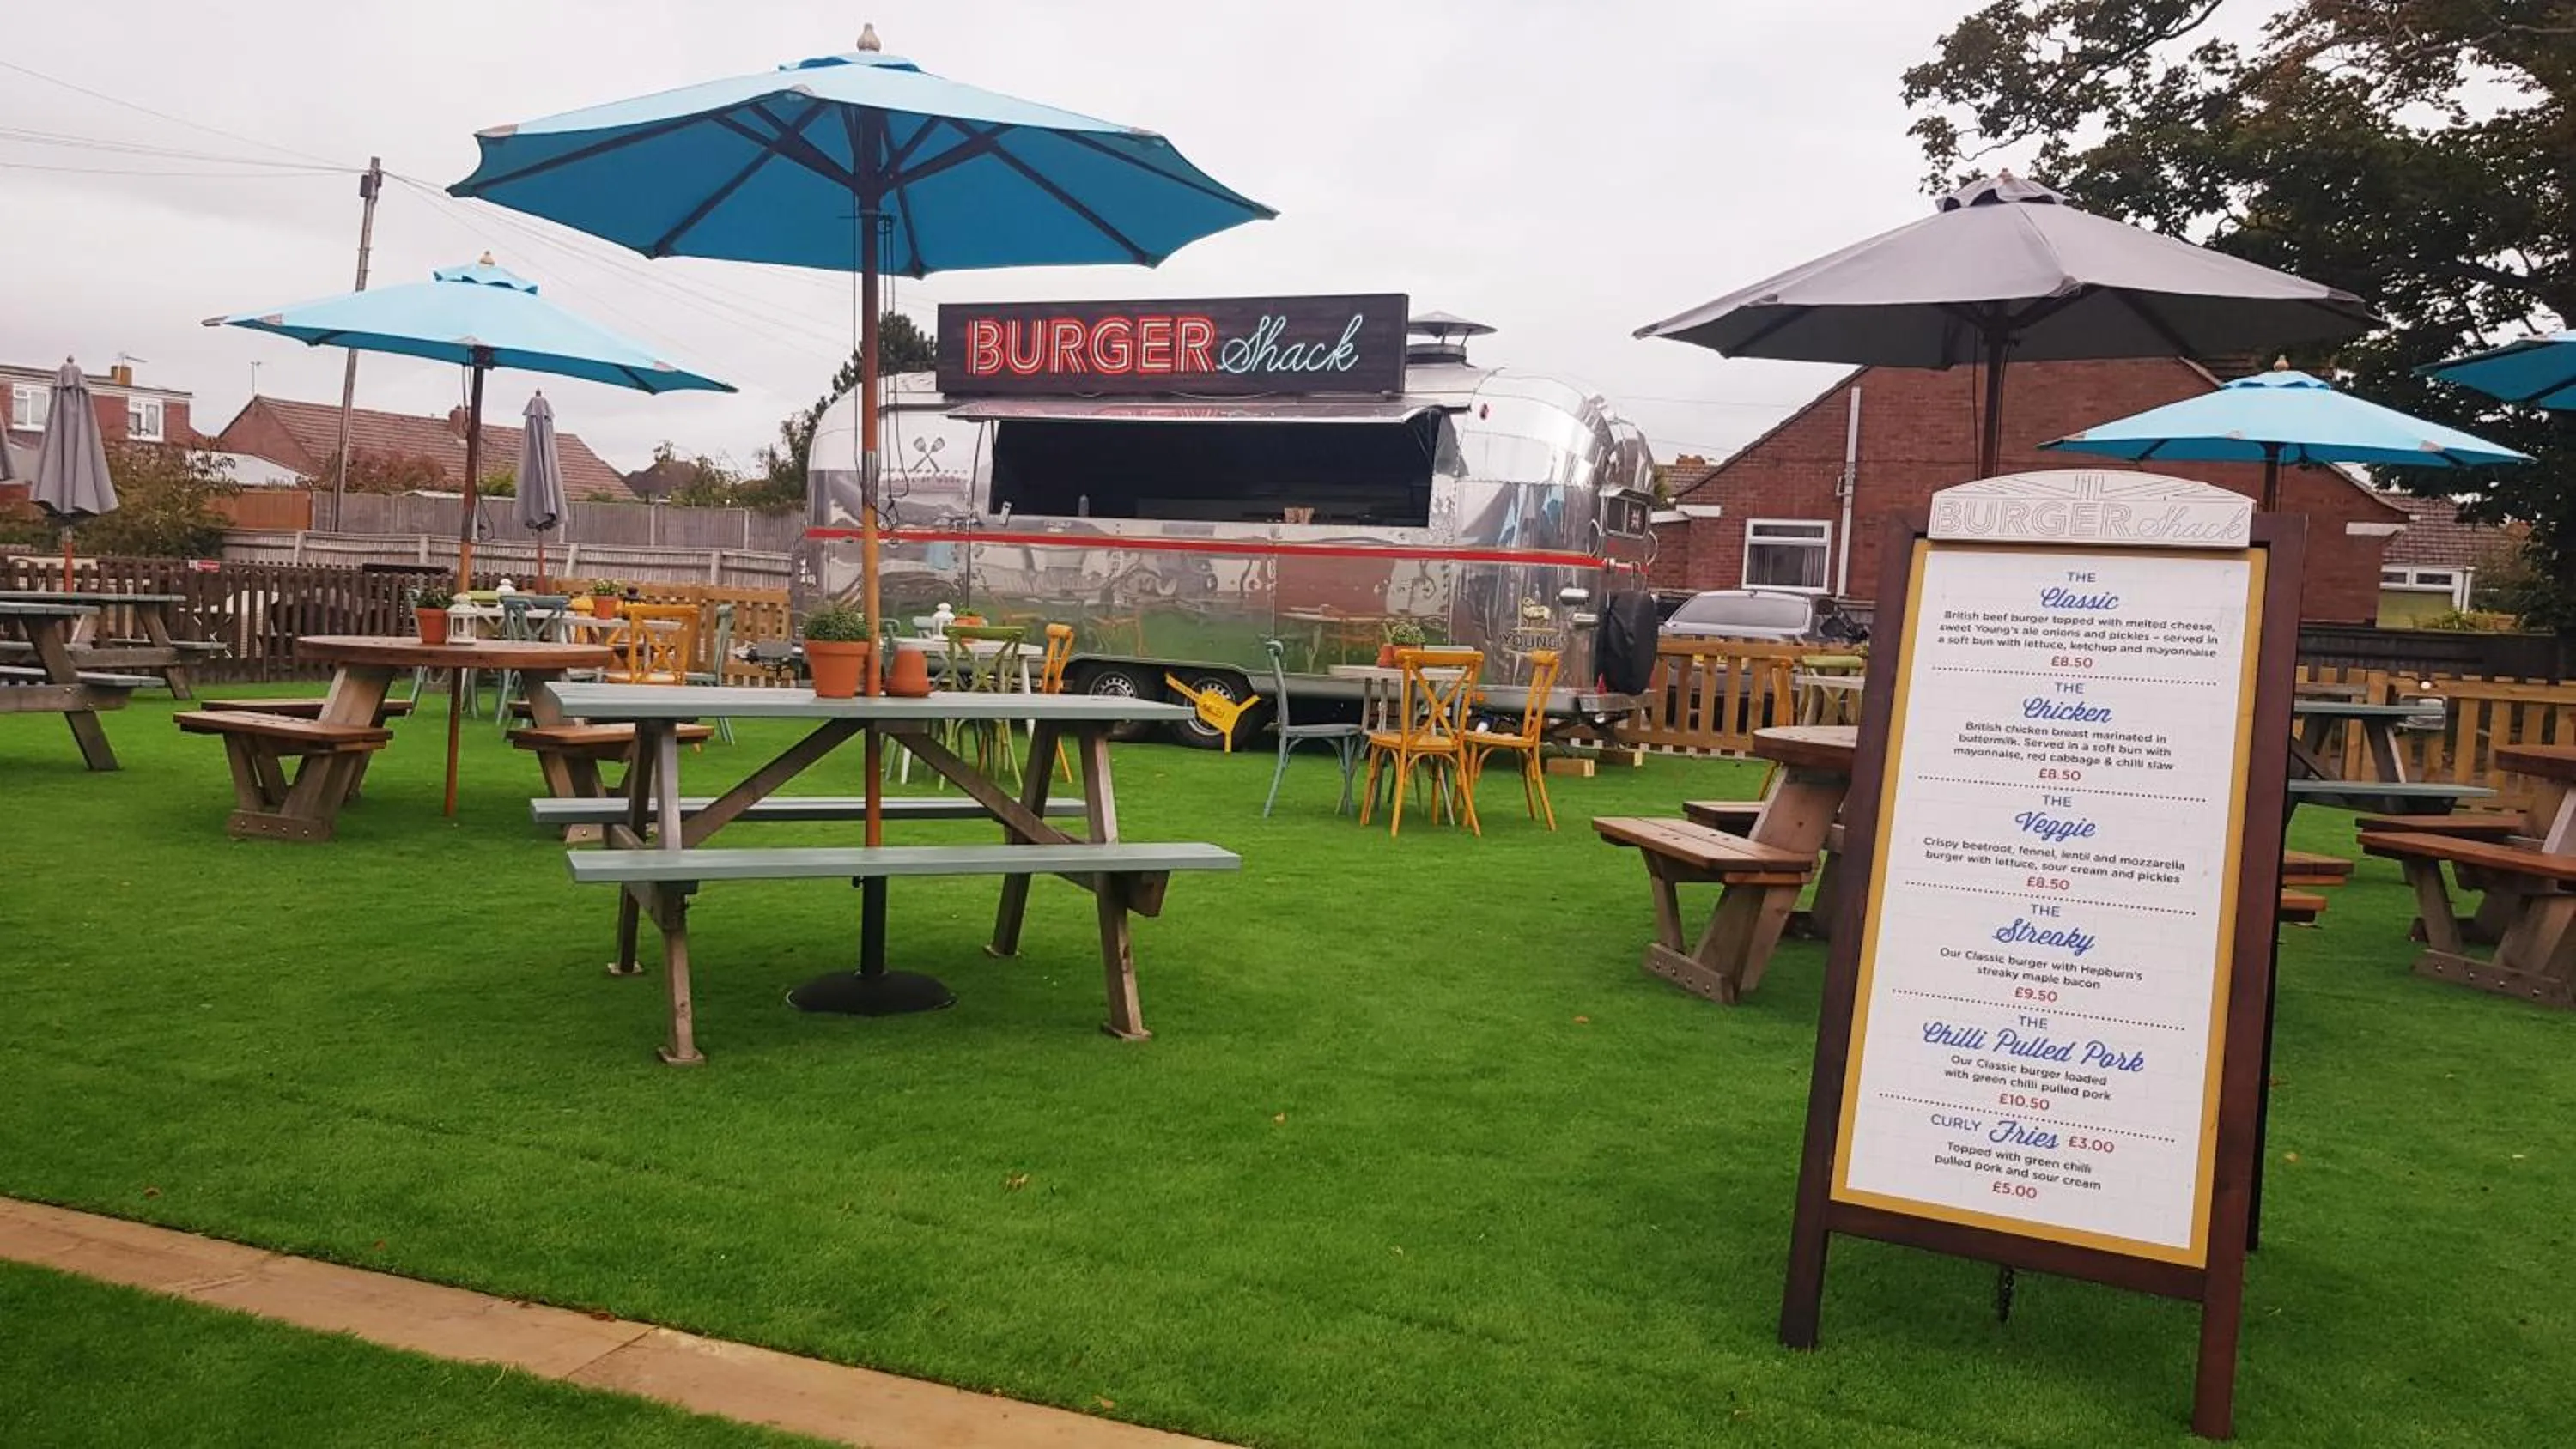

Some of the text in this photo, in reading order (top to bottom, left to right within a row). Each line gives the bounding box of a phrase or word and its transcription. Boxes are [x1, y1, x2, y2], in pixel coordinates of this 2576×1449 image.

[967, 313, 1364, 375] BURGER Shack
[1932, 499, 2248, 541] BURGER Shack
[2068, 572, 2095, 583] THE
[2041, 587, 2119, 611] Classic
[1944, 610, 2215, 633] British beef burger topped with melted cheese,
[1939, 624, 1971, 634] sweet
[1973, 625, 2019, 638] Young's
[2022, 627, 2038, 637] ale
[2040, 627, 2081, 639] onions
[2083, 630, 2106, 640] and
[2109, 630, 2151, 642] pickles
[2163, 634, 2204, 644] served
[2207, 634, 2218, 644] in
[1947, 636, 1969, 646] soft
[1972, 637, 1994, 647] bun
[1997, 639, 2020, 648] with
[2024, 640, 2067, 652] lettuce,
[2069, 641, 2117, 655] ketchup
[2120, 644, 2142, 653] and
[2146, 646, 2216, 657] mayonnaise
[2051, 657, 2093, 669] £8.50
[2055, 682, 2084, 694] THE
[2023, 697, 2111, 723] Chicken
[1965, 721, 2166, 743] British chicken breast marinated in
[1959, 734, 2020, 747] buttermilk.
[2022, 738, 2065, 749] Served
[2067, 741, 2079, 750] in
[2092, 743, 2116, 753] soft
[2118, 743, 2143, 755] bun
[2145, 745, 2171, 756] with
[1953, 749, 2173, 769] mayonnaise, red cabbage & chilli slaw
[2039, 768, 2081, 782] £8.50
[2043, 795, 2071, 807] THE
[2015, 811, 2096, 841] Veggie
[1923, 837, 2184, 870] Crispy beetroot, fennel, lentil and mozzarella
[1925, 851, 2180, 883] burger with lettuce, sour cream and pickles
[2027, 876, 2069, 890] £8.50
[2031, 904, 2060, 917] THE
[1993, 919, 2095, 956] Streaky
[1940, 948, 2142, 979] Our Classic burger with Hepburn's
[1978, 967, 2100, 988] streaky maple bacon
[2014, 987, 2057, 1003] £9.50
[2019, 1016, 2047, 1029] THE
[1923, 1022, 2143, 1071] Chilli Pulled Pork
[1951, 1057, 2107, 1085] Our Classic burger loaded
[1945, 1070, 2111, 1100] with green chilli pulled pork
[1999, 1094, 2050, 1111] £10.50
[1931, 1114, 2115, 1153] CURLY Fries £3.00
[1947, 1143, 2092, 1173] Topped with green chilli
[1935, 1157, 2101, 1189] pulled pork and sour cream
[1992, 1181, 2037, 1198] £5.00
